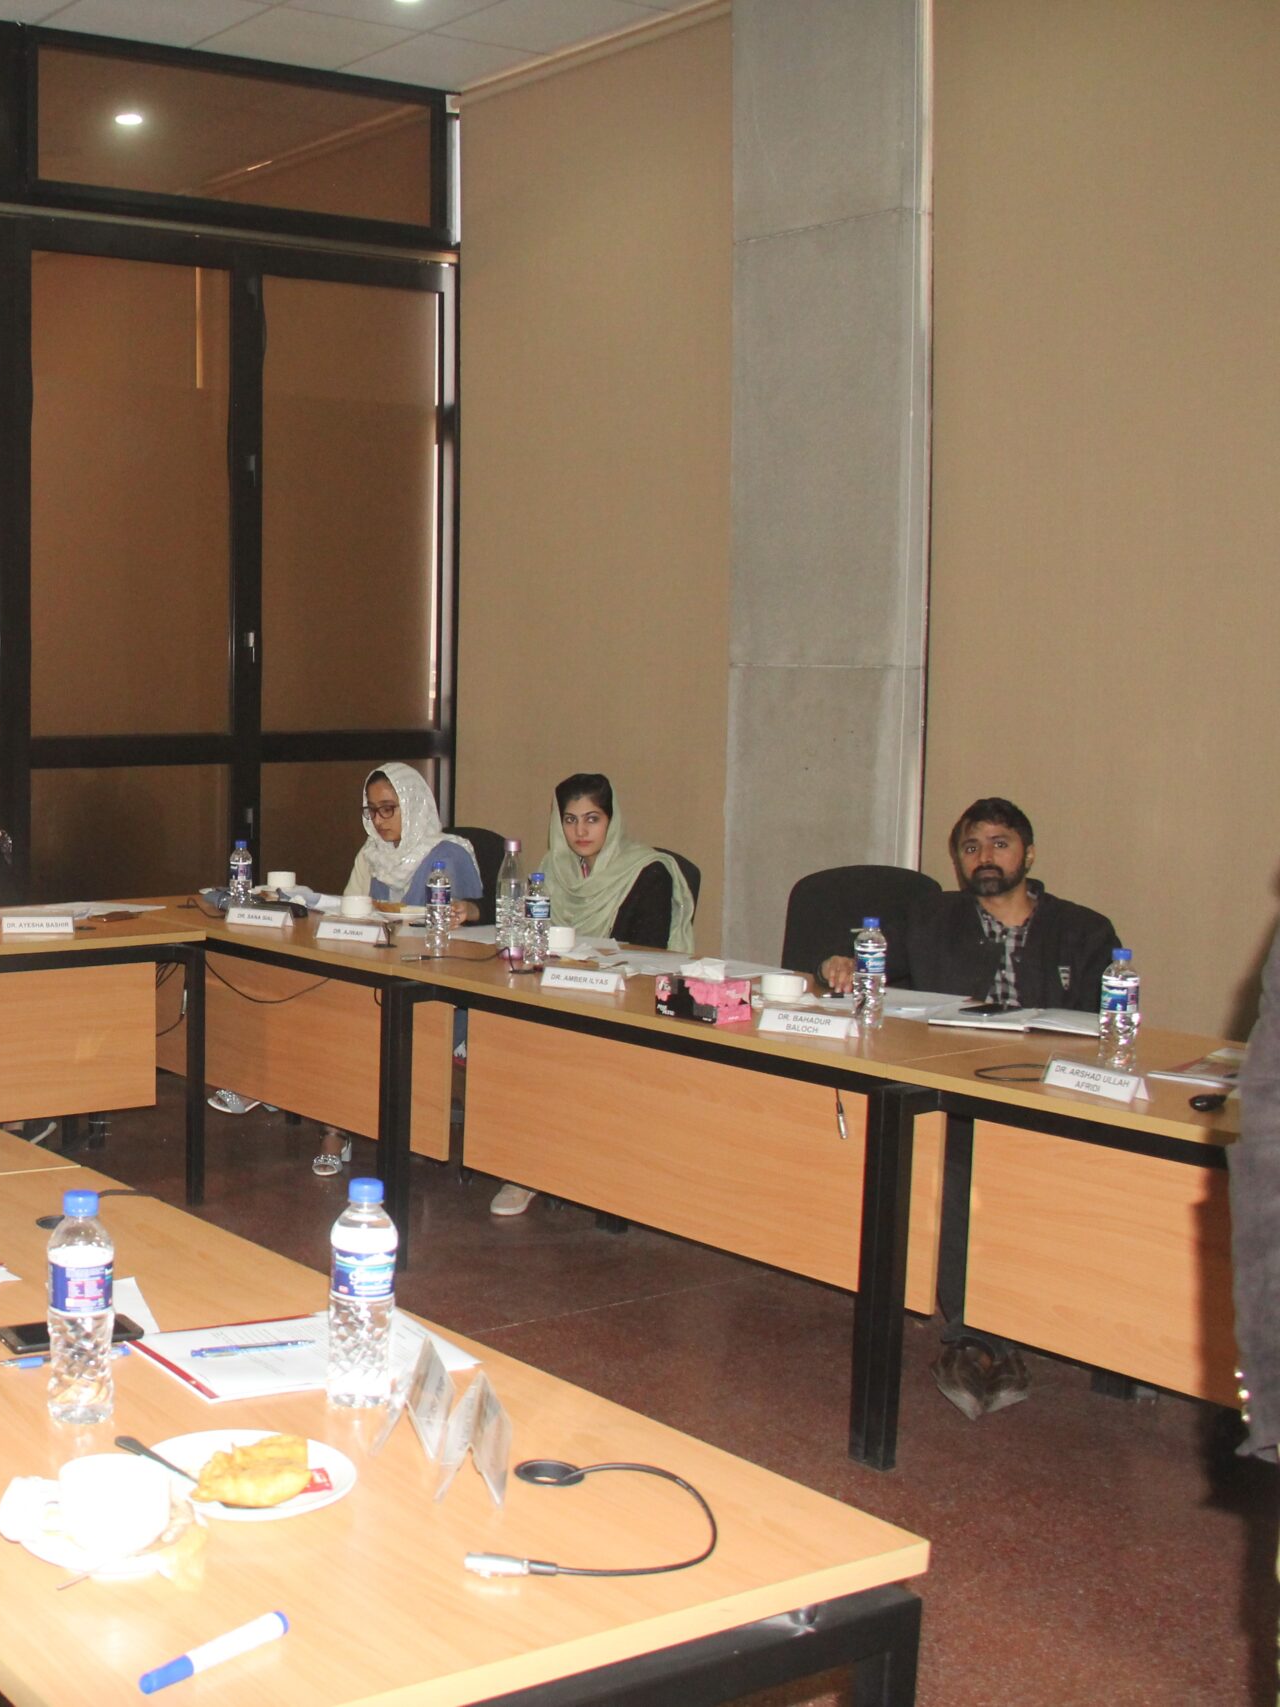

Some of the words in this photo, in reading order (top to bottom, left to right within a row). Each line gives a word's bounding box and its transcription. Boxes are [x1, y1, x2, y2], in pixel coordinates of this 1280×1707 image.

[563, 974, 588, 983] AMBER
[588, 977, 609, 985] ILYAS
[792, 1014, 832, 1026] BAHADUR
[785, 1023, 819, 1033] BALOCH
[1069, 1068, 1102, 1082] ARSHAD
[1102, 1076, 1130, 1088] ULLAH
[1074, 1080, 1101, 1092] AFRIDI
